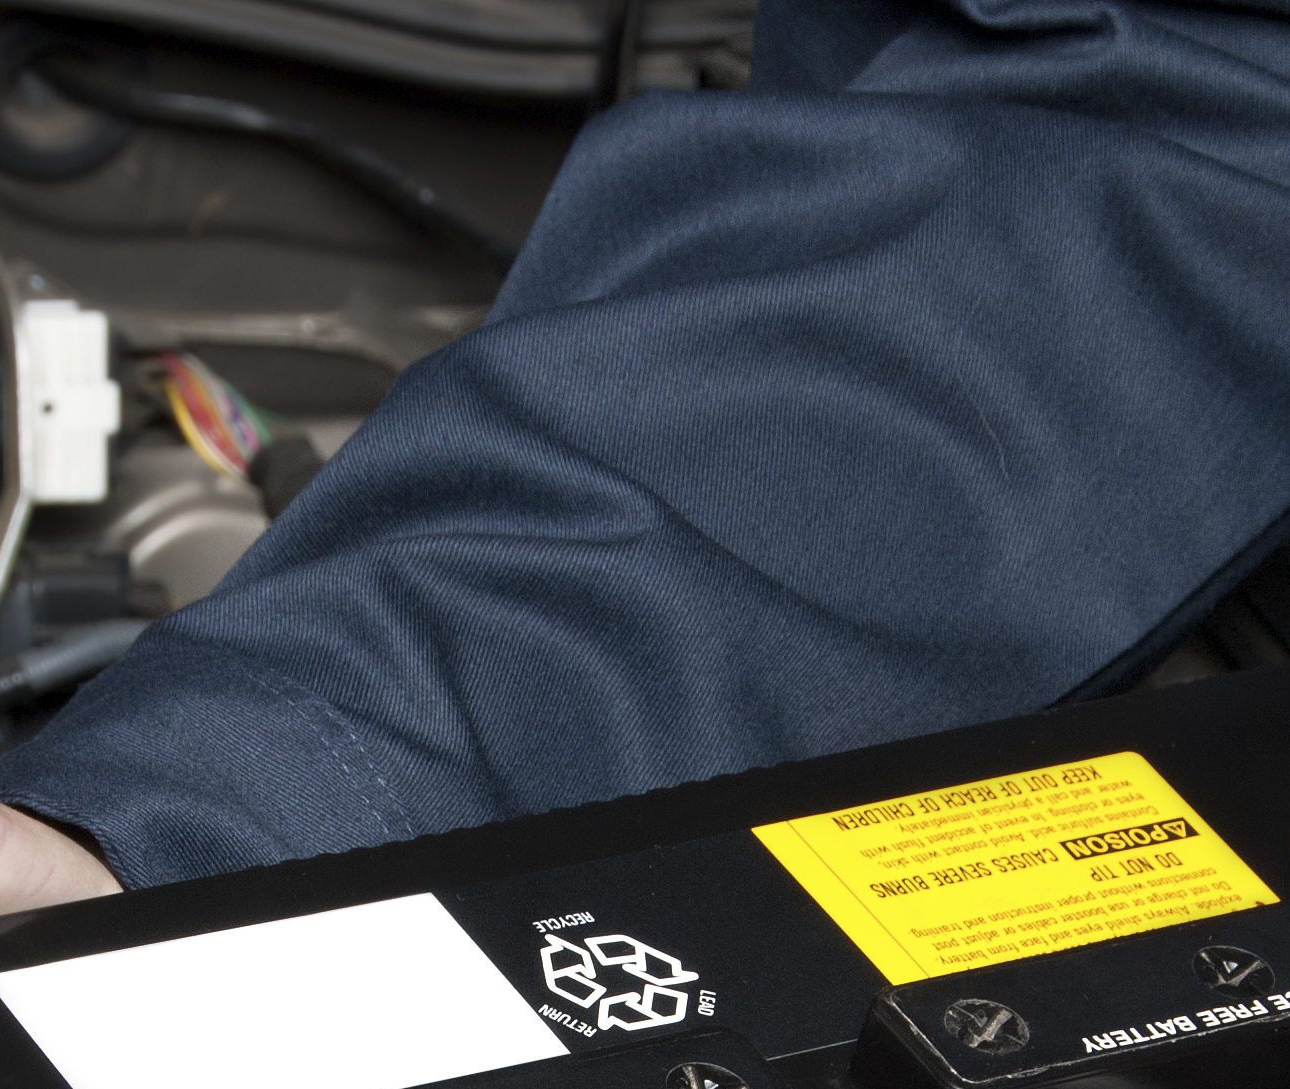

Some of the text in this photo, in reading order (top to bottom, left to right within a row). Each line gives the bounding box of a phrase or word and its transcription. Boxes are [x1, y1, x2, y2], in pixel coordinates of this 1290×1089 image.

[1069, 787, 1094, 800] and
[1097, 779, 1134, 793] water
[832, 766, 1101, 831] KEEP OUT OF REACH OF CHILDREN
[975, 796, 1034, 817] physician
[1045, 791, 1070, 805] call
[978, 823, 994, 835] of
[993, 815, 1030, 830] event
[1057, 815, 1105, 833] sulfuric
[924, 826, 977, 845] accident
[988, 831, 1026, 848] Avoid
[859, 845, 891, 860] with
[890, 837, 926, 853] flush
[941, 839, 989, 857] contact
[870, 822, 1168, 898] POISON CAUSES SEVERE BURNS
[877, 856, 910, 870] skin,
[910, 850, 942, 864] with
[1090, 852, 1183, 881] DO NOT TIP
[1145, 867, 1218, 888] connections
[1210, 880, 1233, 892] Do
[1056, 890, 1097, 908] proper
[1097, 882, 1147, 899] without
[1146, 889, 1189, 904] charge
[1188, 884, 1211, 897] not
[987, 901, 1057, 922] instruction
[1060, 906, 1110, 923] booster
[1106, 901, 1130, 912] use
[1142, 904, 1191, 921] Always
[533, 911, 595, 933] RECYCLE
[962, 916, 987, 931] and
[1016, 916, 1059, 932] cables
[1104, 914, 1143, 932] shield
[931, 936, 961, 952] post
[960, 929, 1001, 946] adjust
[1018, 935, 1050, 948] face
[1048, 930, 1073, 944] and
[933, 949, 989, 965] battery.
[986, 942, 1021, 956] from
[697, 990, 716, 1017] LEAD
[538, 1003, 598, 1038] RETURN
[1197, 999, 1269, 1027] FREE
[1082, 1015, 1197, 1054] BATTERY
